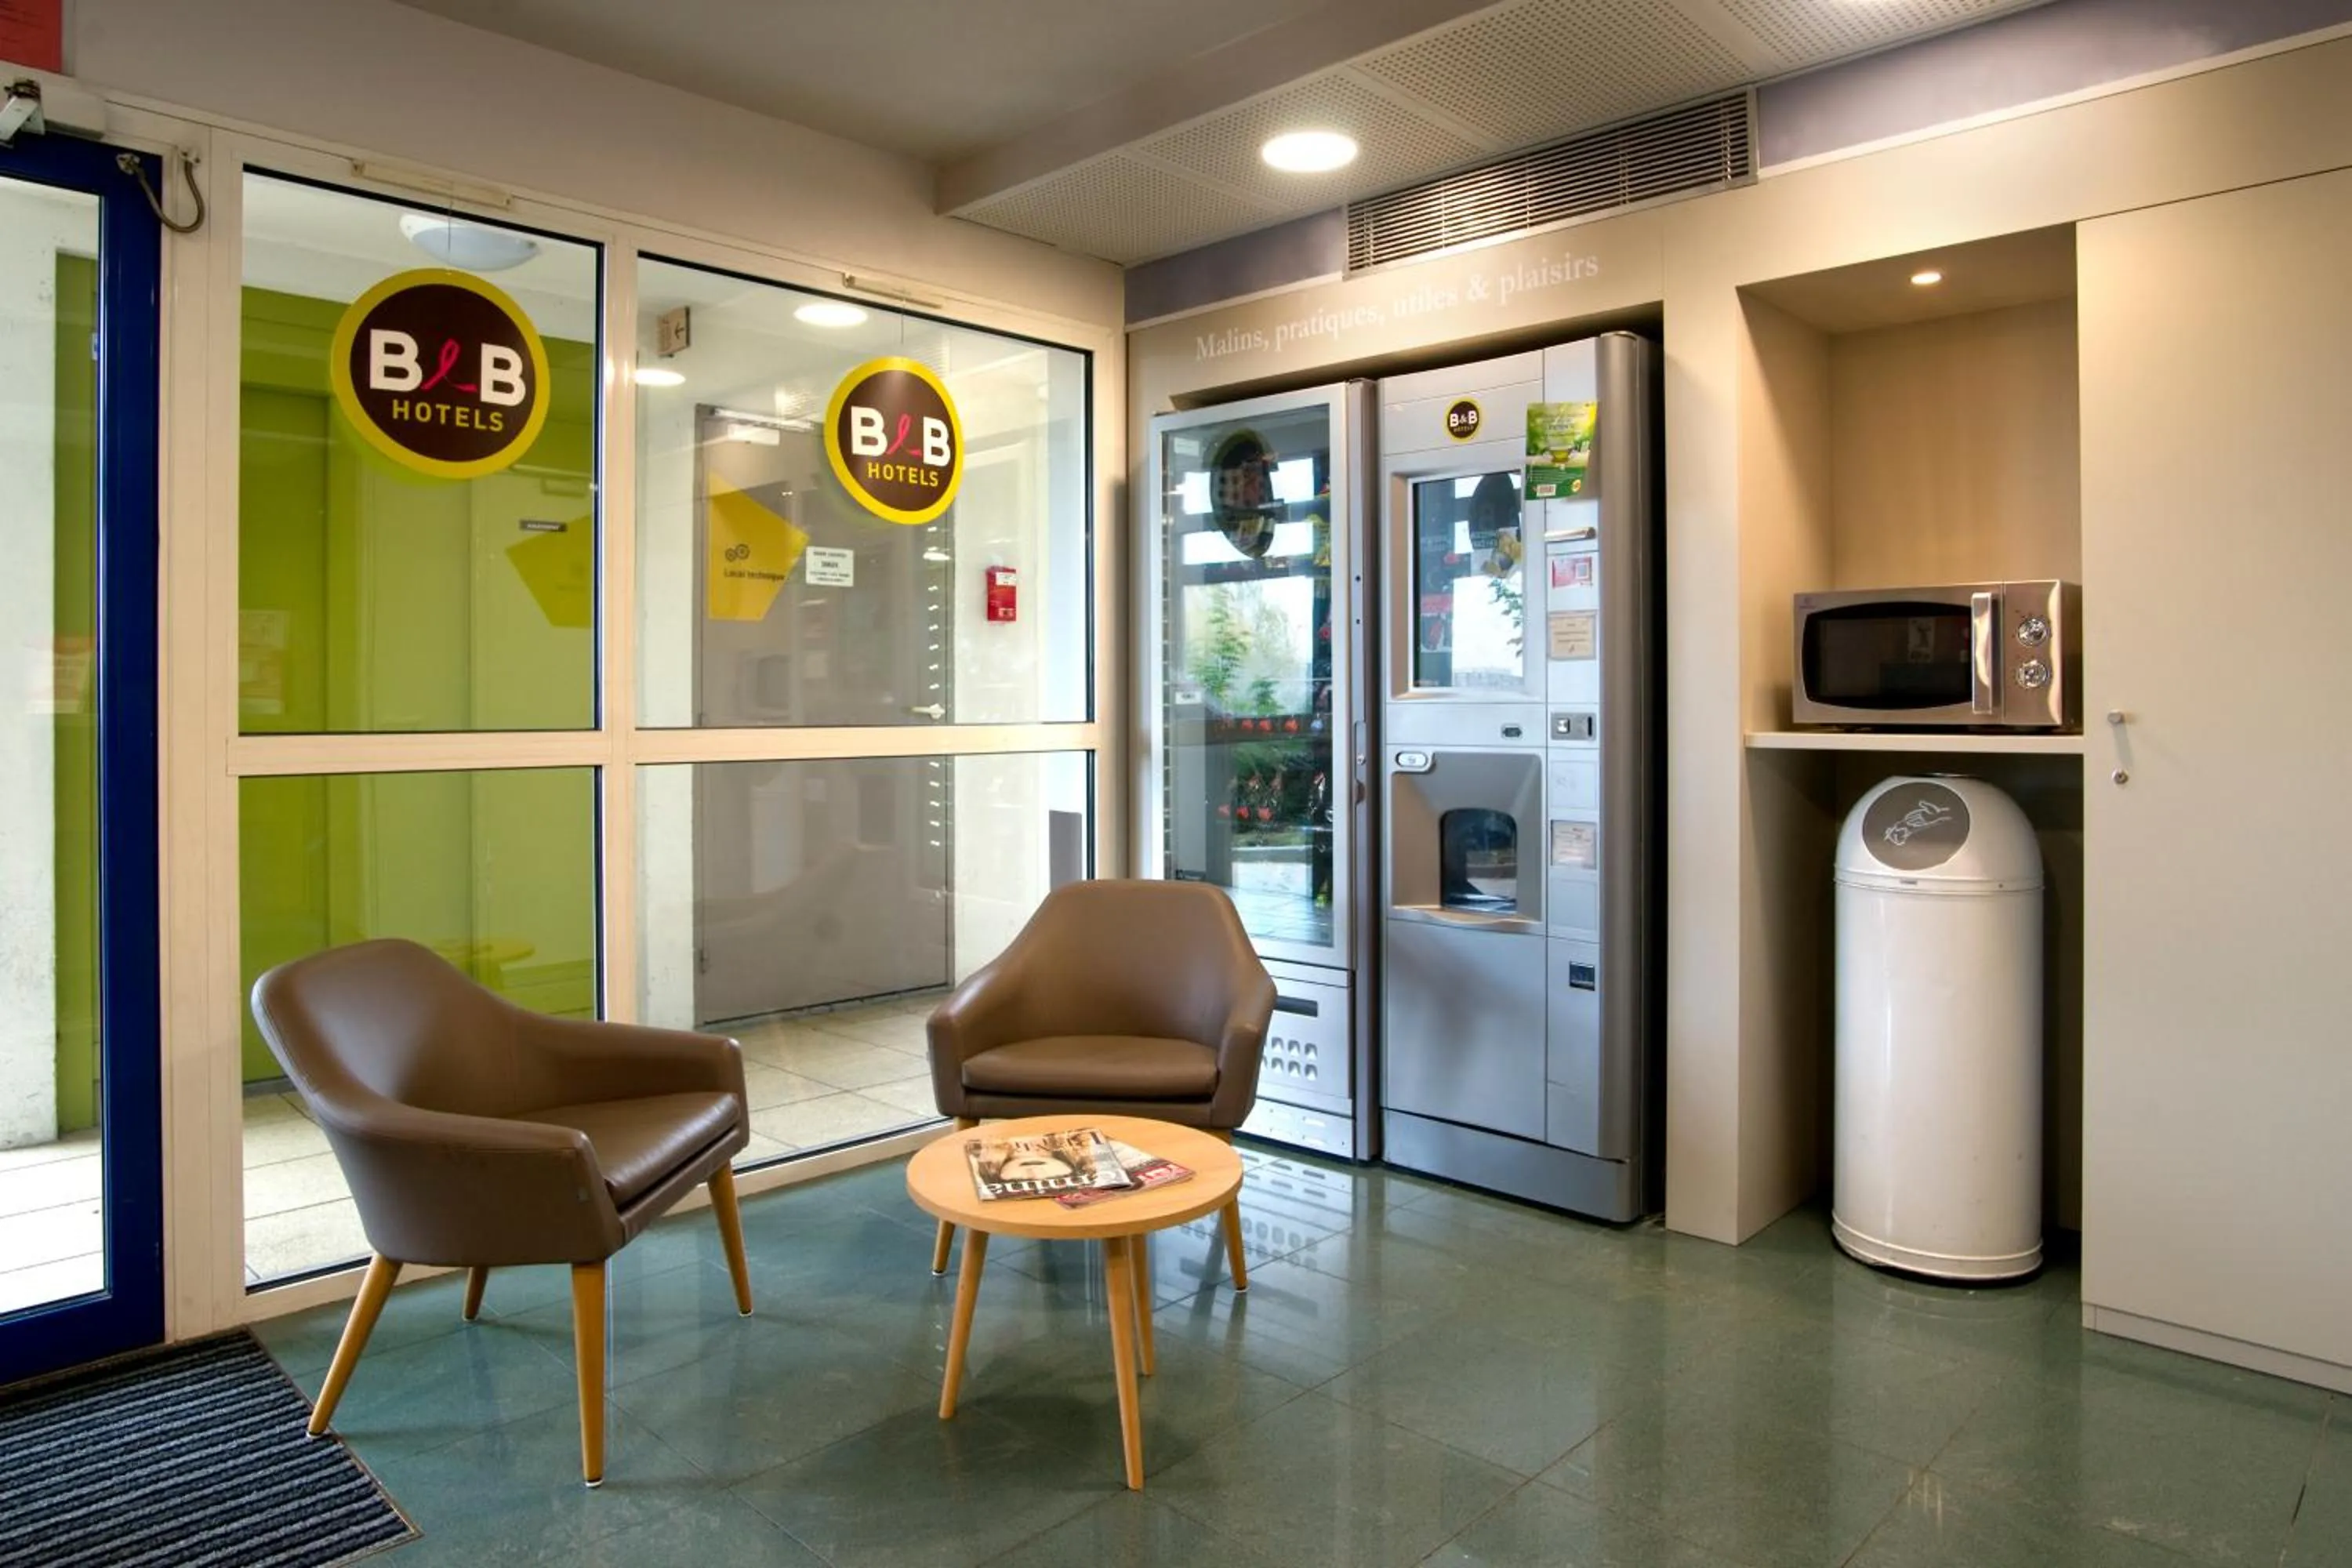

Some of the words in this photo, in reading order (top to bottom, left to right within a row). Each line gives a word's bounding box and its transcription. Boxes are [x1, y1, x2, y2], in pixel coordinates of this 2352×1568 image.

[1196, 327, 1269, 360] Malins,
[1274, 305, 1386, 352] pratiques,
[1393, 284, 1459, 317] utiles
[1466, 274, 1491, 302] &
[1497, 251, 1599, 306] plaisirs
[392, 399, 505, 433] HOTELS
[1450, 410, 1478, 427] B&B
[867, 462, 939, 488] HOTELS
